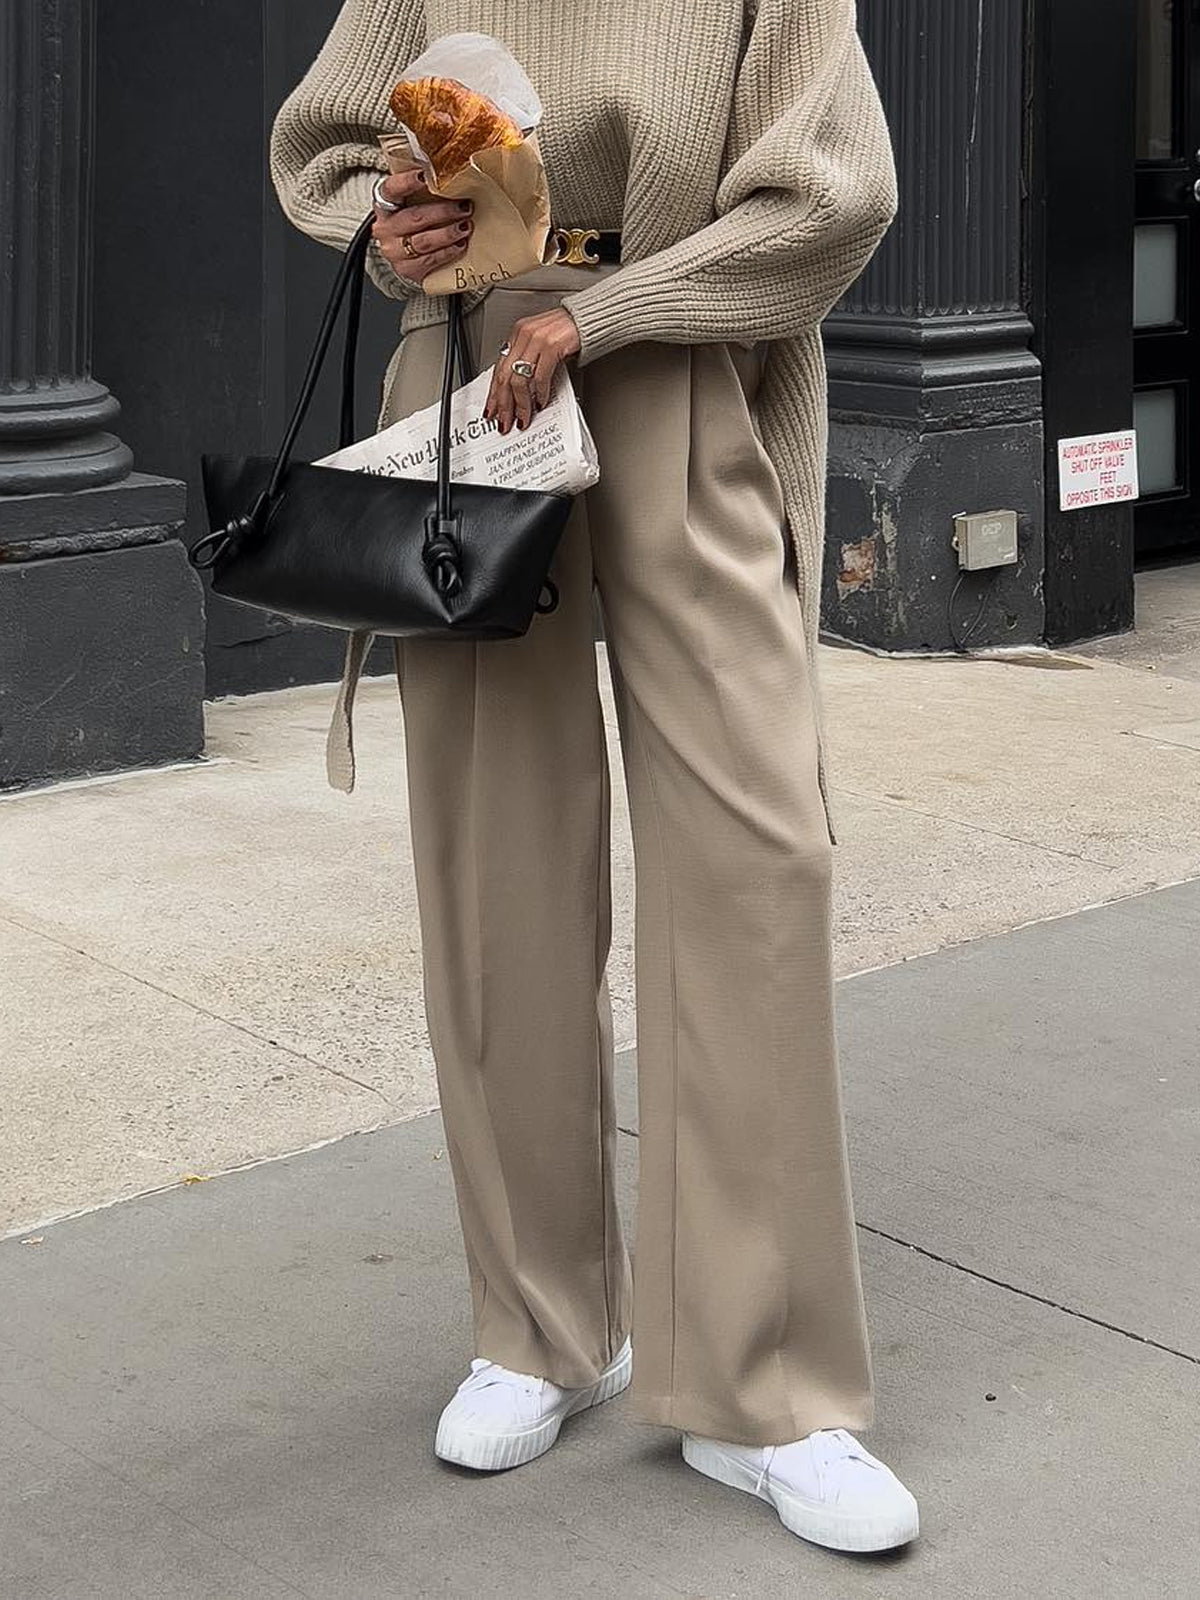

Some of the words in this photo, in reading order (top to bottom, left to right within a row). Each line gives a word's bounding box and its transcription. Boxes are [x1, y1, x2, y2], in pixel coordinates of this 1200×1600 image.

[455, 263, 514, 289] Birch
[425, 428, 466, 463] Yrk
[467, 417, 498, 439] Tim
[485, 439, 528, 463] WRAPPING
[528, 433, 539, 445] UP
[513, 447, 538, 465] PANEL
[538, 432, 563, 451] PLANS
[1063, 442, 1096, 459] AUTOMATIC
[1098, 437, 1133, 454] SPRINKLER
[499, 464, 526, 484] TRUMP
[526, 445, 566, 471] SUBPOENA
[1071, 459, 1088, 474] SHUT
[1090, 457, 1102, 471] OFF
[1105, 454, 1124, 468] VALVE
[1100, 470, 1116, 485] FEET
[1066, 488, 1098, 506] OPPOSITE
[1100, 486, 1114, 500] THIS
[1116, 484, 1132, 498] SIGN
